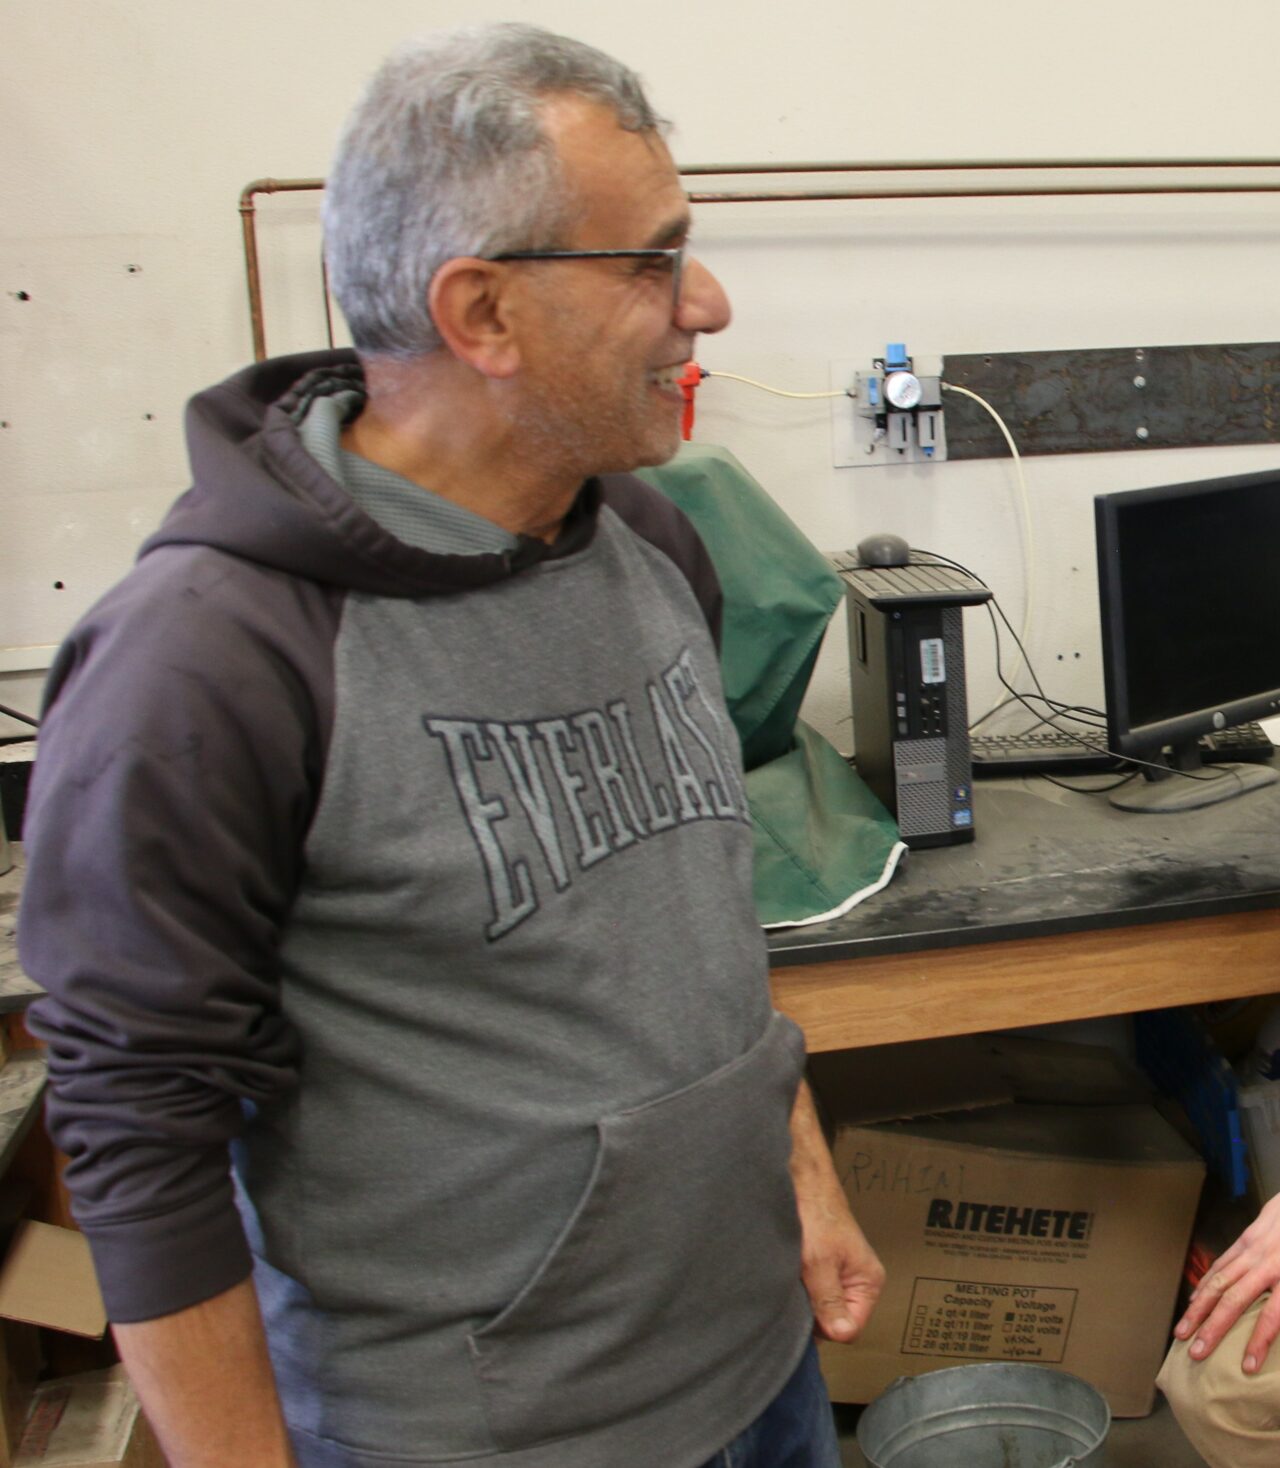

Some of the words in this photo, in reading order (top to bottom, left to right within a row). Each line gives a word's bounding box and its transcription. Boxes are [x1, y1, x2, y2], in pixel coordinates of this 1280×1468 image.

[926, 1199, 1088, 1241] RITEHETE
[955, 1283, 1009, 1297] MELTING
[1012, 1288, 1037, 1298] POT
[944, 1294, 994, 1308] Capacity
[1014, 1300, 1057, 1312] Voltage
[1018, 1314, 1037, 1323] 120
[1039, 1314, 1064, 1325] volts
[1037, 1325, 1061, 1335] volts
